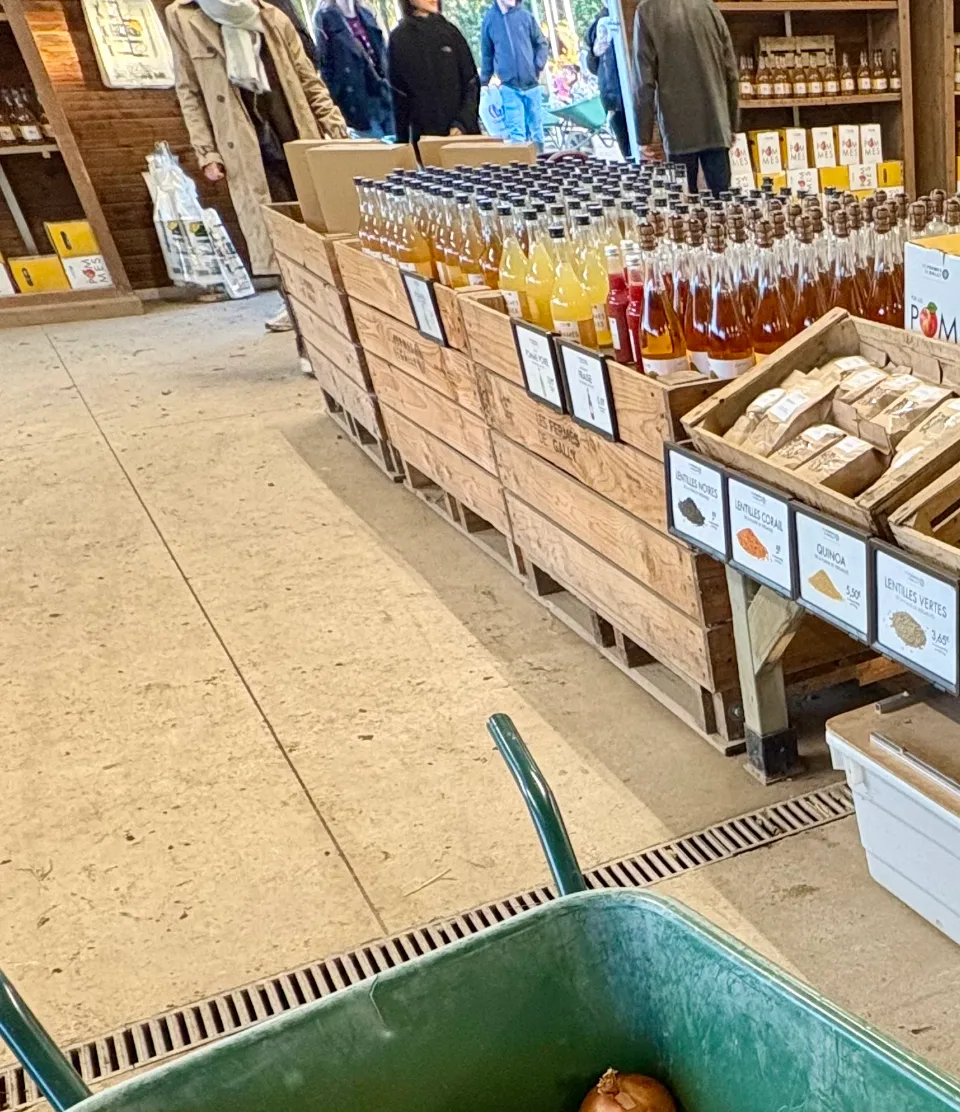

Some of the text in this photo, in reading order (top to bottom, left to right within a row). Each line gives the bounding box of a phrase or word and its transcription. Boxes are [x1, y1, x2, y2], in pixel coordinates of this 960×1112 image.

[734, 499, 761, 523] LENTILLES
[761, 512, 784, 532] CORAIL
[816, 543, 846, 567] QUINOA
[884, 576, 917, 604] LENTILLES
[918, 593, 948, 619] VERTES
